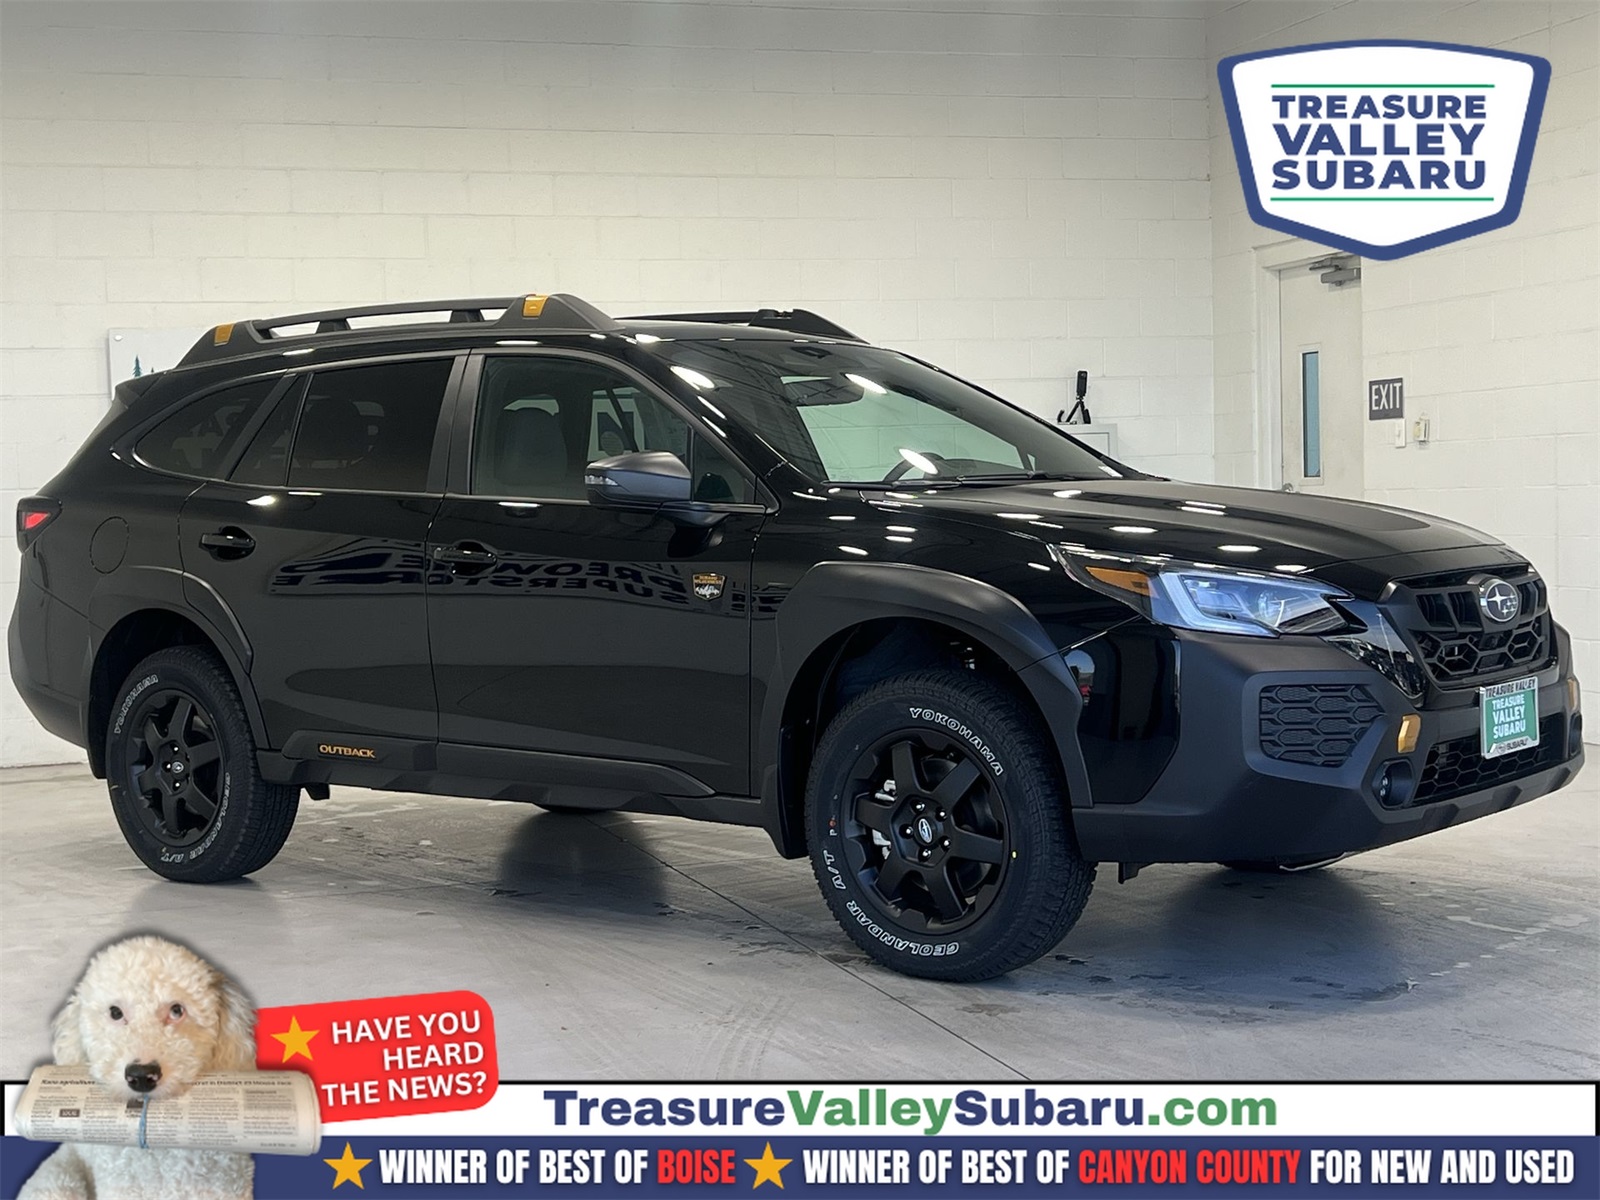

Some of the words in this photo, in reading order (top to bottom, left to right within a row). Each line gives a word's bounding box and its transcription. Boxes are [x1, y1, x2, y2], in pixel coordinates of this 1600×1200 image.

[1371, 383, 1402, 410] EXIT
[1492, 694, 1525, 710] TREASURE
[1493, 705, 1525, 724] VALLEY
[1493, 719, 1526, 739] SUBARU
[319, 744, 376, 758] OUTBACK
[909, 707, 1004, 776] YOKOHAMA
[823, 850, 847, 890] A/T
[846, 900, 960, 956] GEOLANDAR
